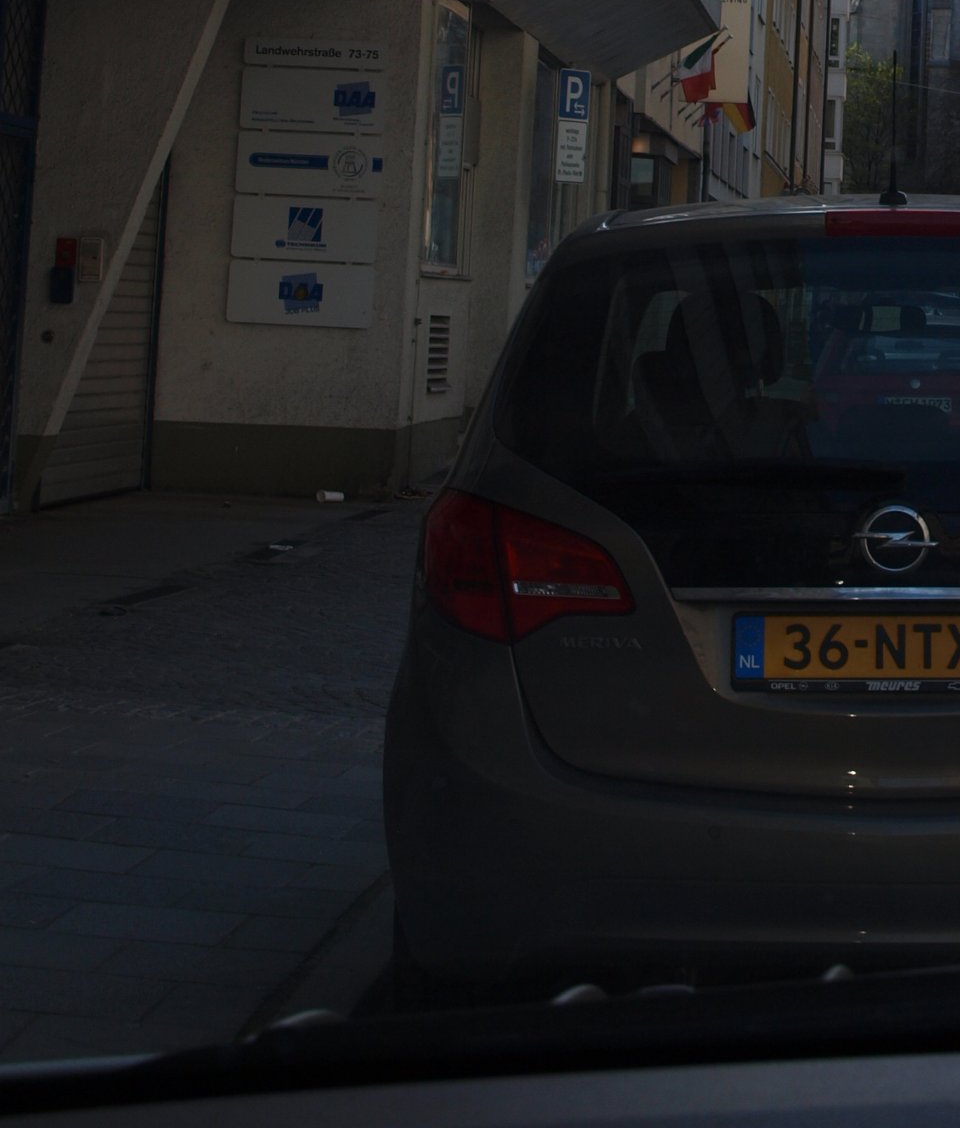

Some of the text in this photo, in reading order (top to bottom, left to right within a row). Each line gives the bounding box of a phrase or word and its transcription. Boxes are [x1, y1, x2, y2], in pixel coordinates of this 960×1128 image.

[256, 45, 379, 60] Landwehrstraße 73-75
[566, 76, 583, 112] P
[739, 654, 760, 669] NL
[771, 682, 796, 690] OPEL
